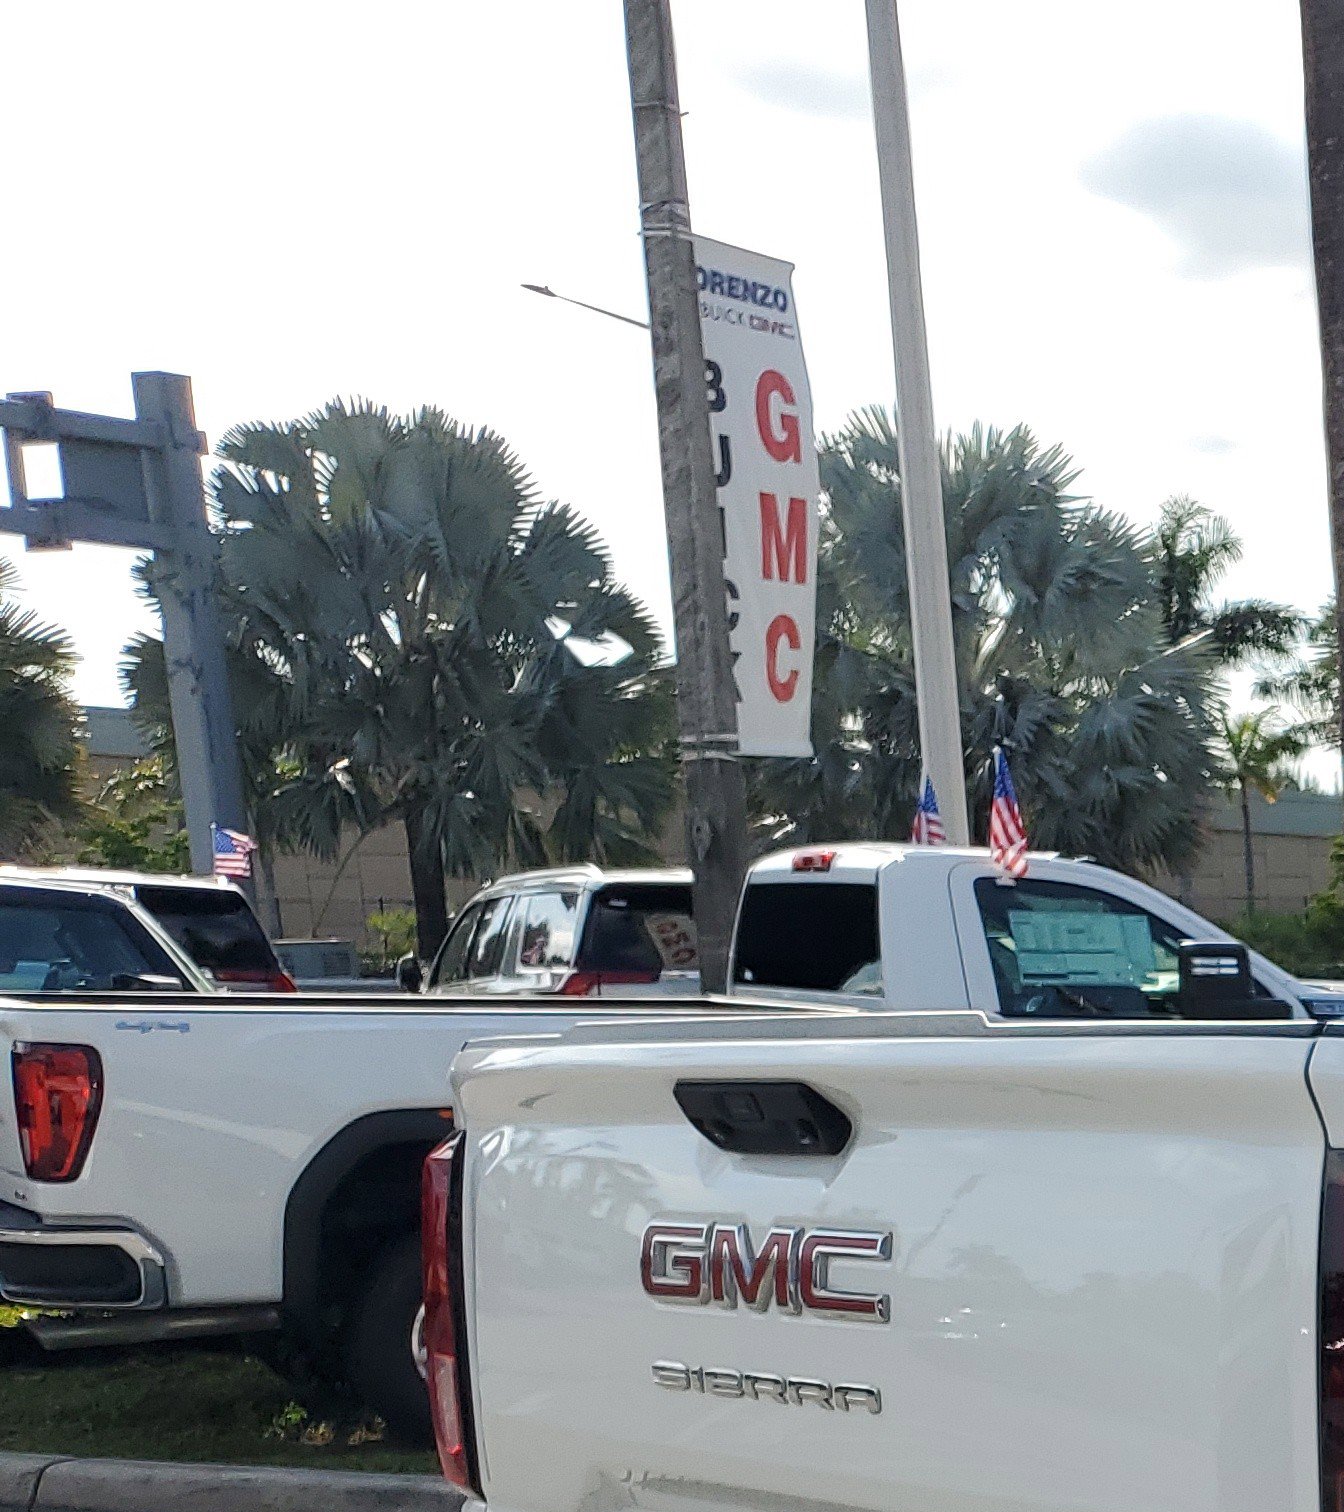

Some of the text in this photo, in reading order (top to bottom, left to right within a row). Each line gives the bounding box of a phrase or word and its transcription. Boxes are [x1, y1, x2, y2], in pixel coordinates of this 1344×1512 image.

[696, 266, 787, 312] ORENZO
[640, 1221, 893, 1323] GMC
[651, 1359, 882, 1415] SIERRA
